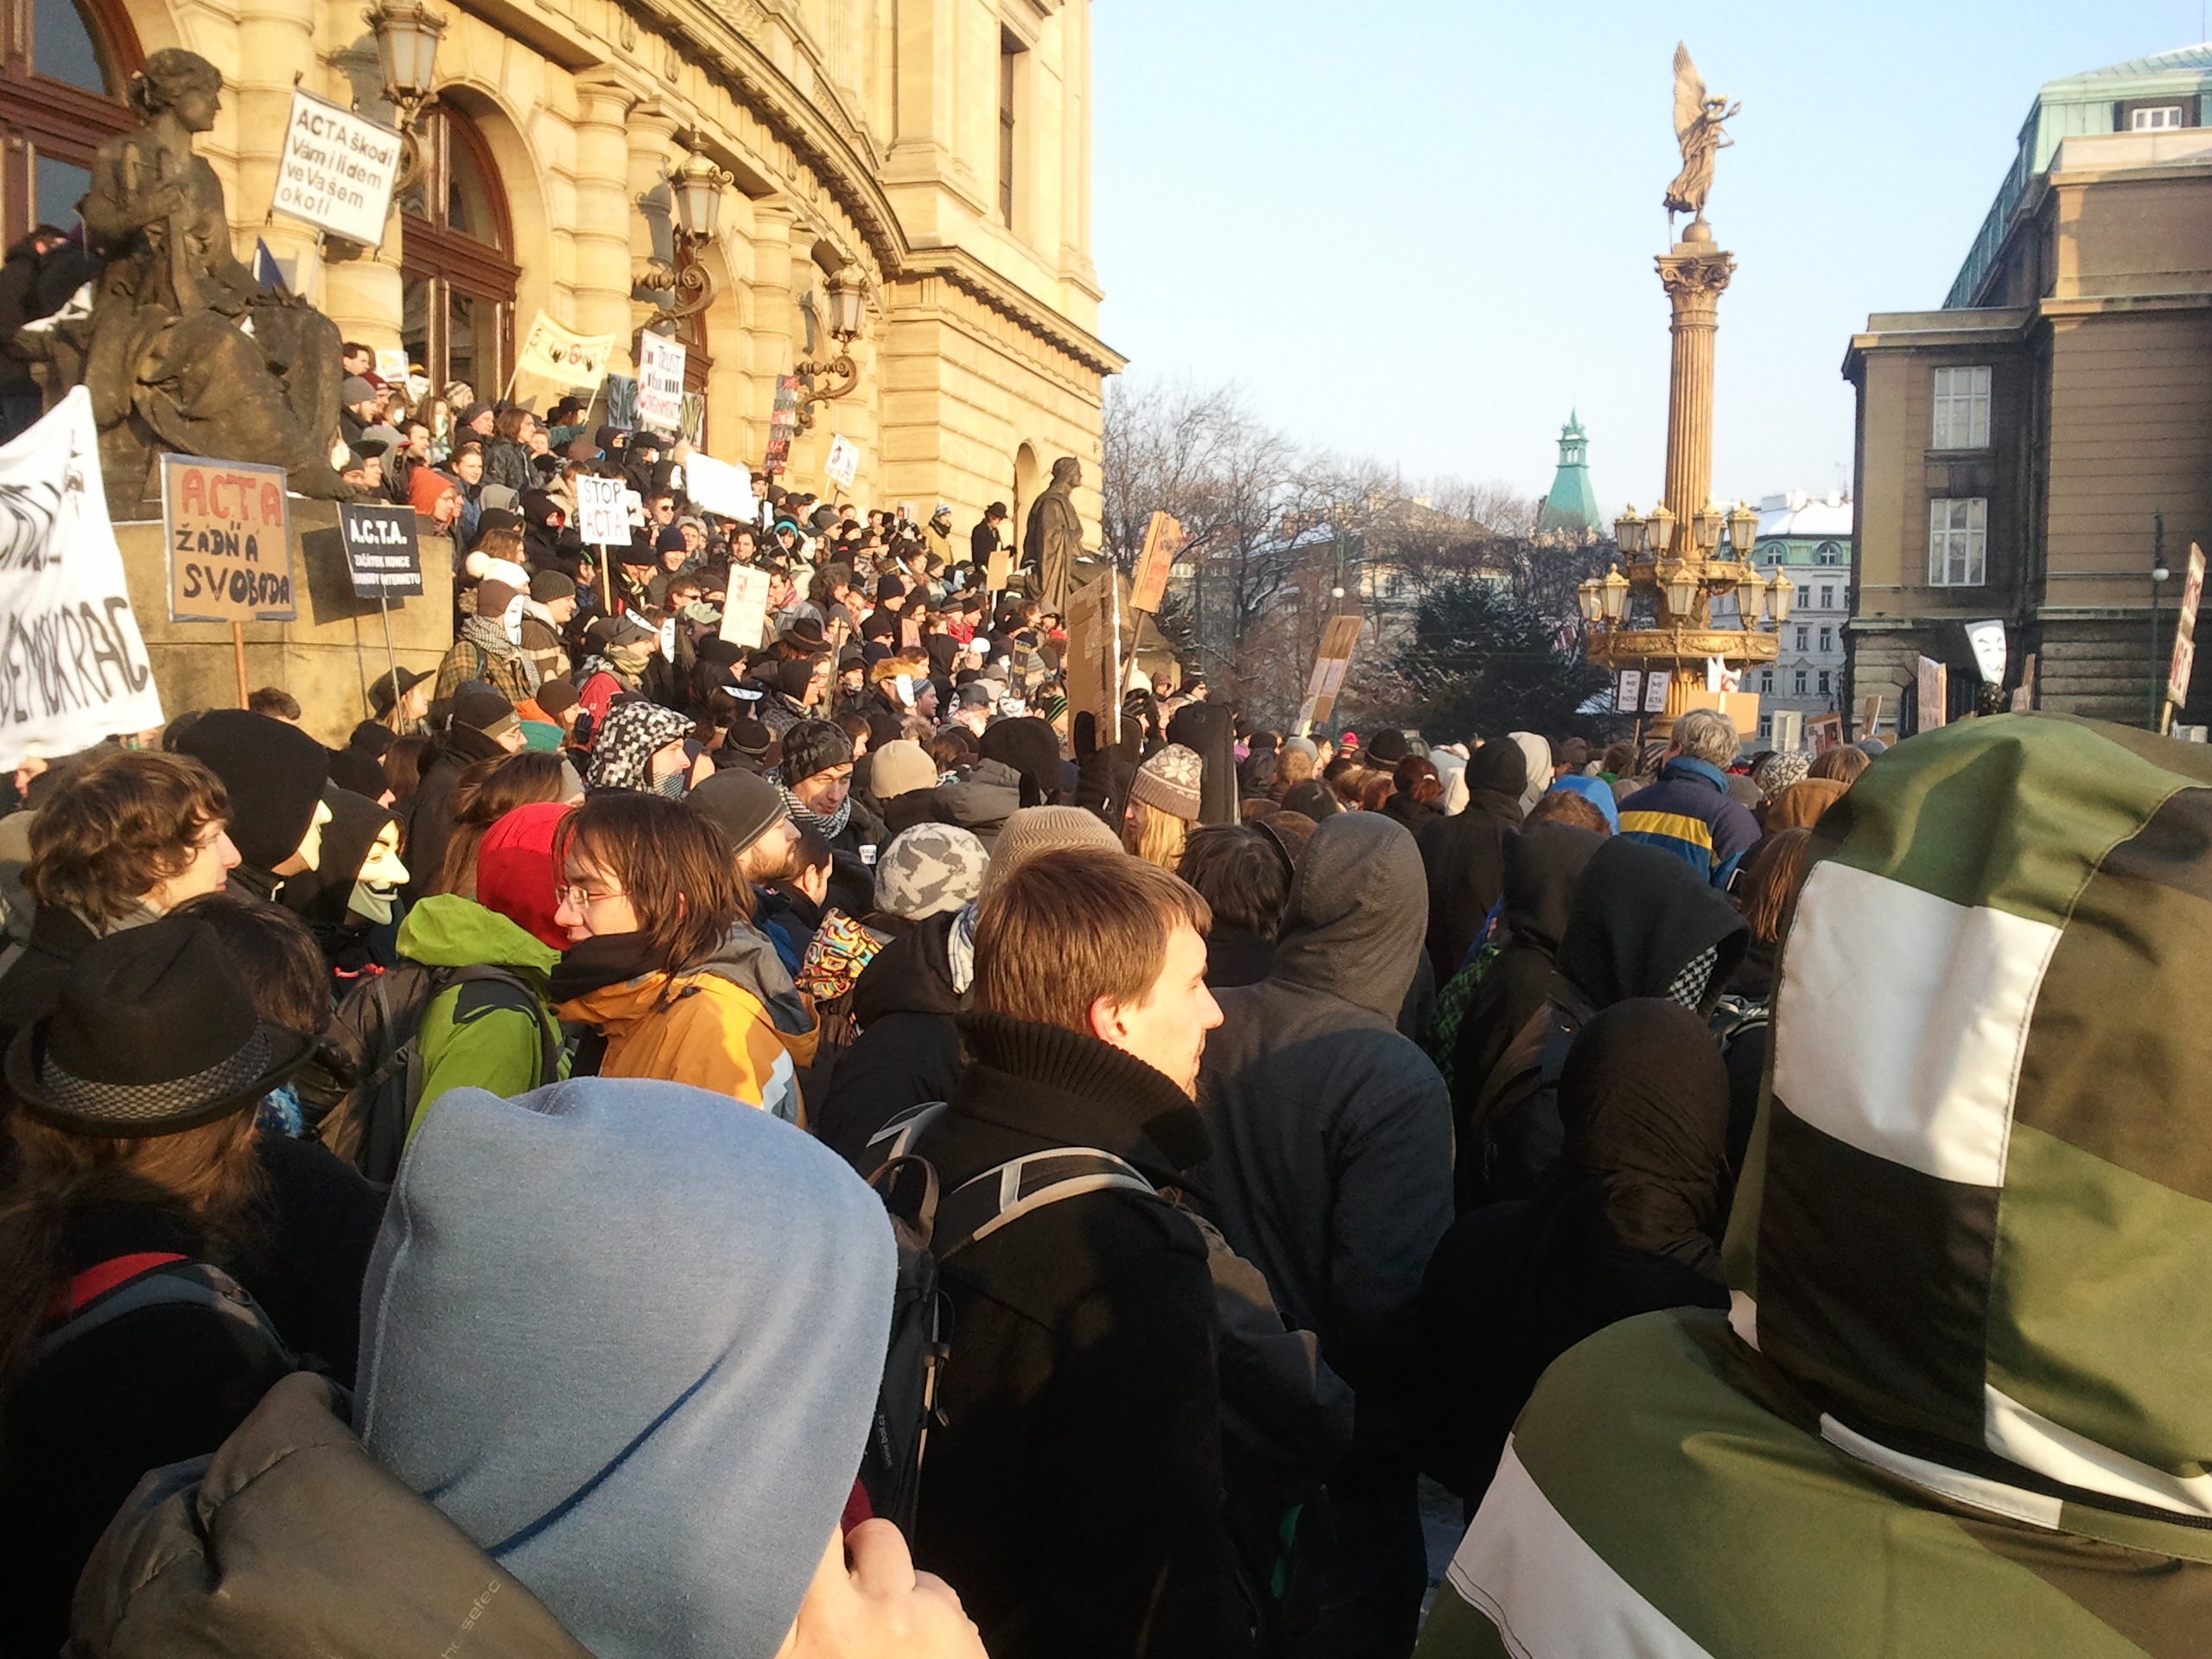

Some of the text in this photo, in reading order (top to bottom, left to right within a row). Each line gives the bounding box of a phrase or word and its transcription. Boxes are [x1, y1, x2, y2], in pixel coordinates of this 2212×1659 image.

[296, 108, 346, 146] ACTA
[287, 162, 364, 209] ve Vašem
[327, 150, 335, 169] i
[336, 153, 382, 190] lidem
[658, 346, 682, 375] TRUST
[181, 468, 283, 527] ACTA
[584, 479, 620, 504] STOP
[350, 518, 408, 544] A.C.T.A.
[587, 509, 624, 537] ACTA
[183, 563, 289, 607] SVOBODA
